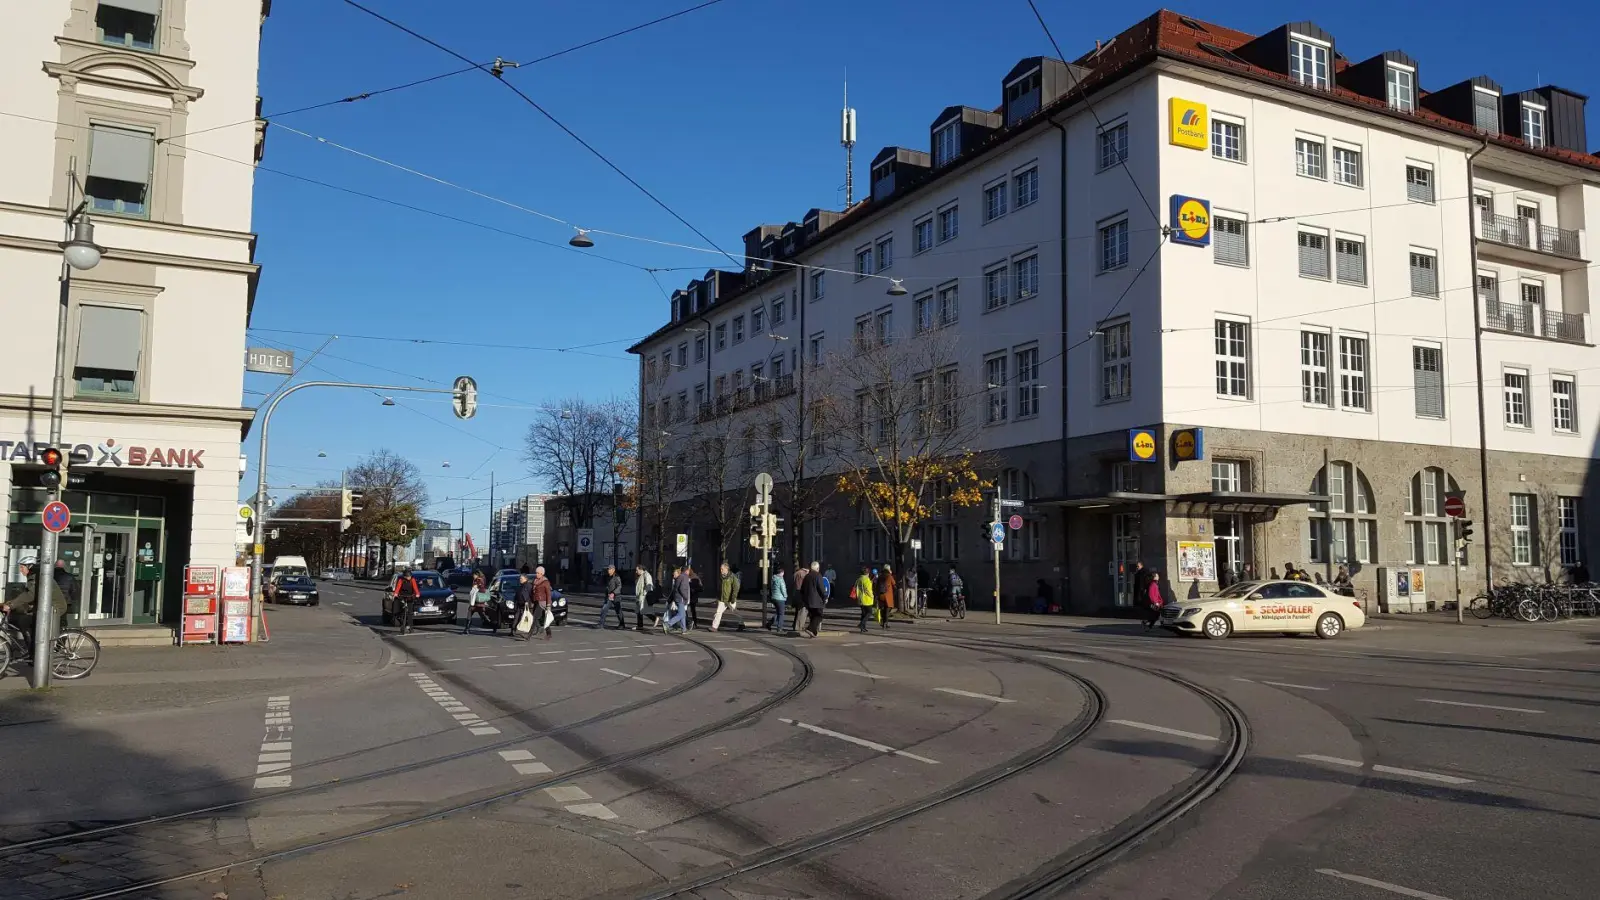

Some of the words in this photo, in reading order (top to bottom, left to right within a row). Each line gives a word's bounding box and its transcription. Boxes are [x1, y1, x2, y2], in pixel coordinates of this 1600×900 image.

[1177, 126, 1205, 139] Postbank
[249, 353, 292, 368] HOTEL
[0, 440, 94, 464] TARO
[128, 446, 205, 468] BANK
